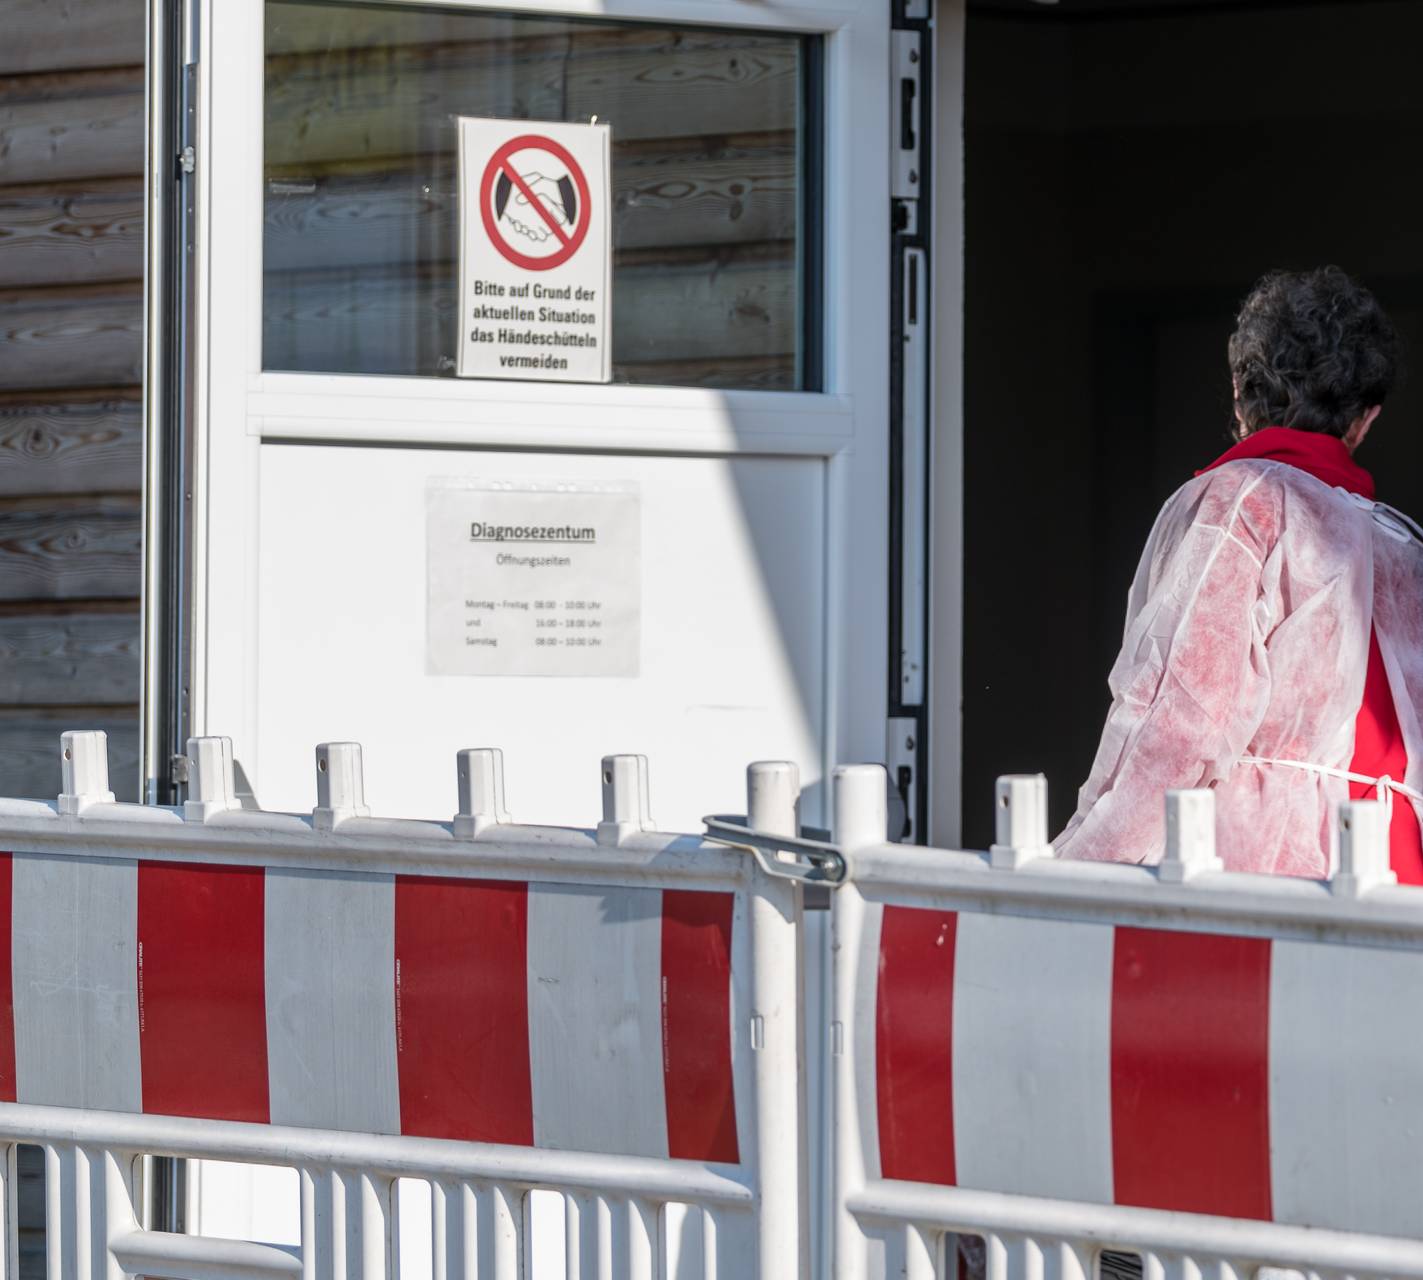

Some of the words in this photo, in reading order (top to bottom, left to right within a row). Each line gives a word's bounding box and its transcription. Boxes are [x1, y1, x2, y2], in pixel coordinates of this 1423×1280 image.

[474, 280, 505, 297] Bitte
[509, 283, 529, 298] auf
[533, 283, 571, 300] Grund
[575, 286, 595, 301] der
[473, 304, 535, 321] aktuellen
[539, 307, 596, 324] Situation
[470, 327, 494, 343] das
[498, 328, 597, 347] Händeschütteln
[499, 353, 568, 369] vermeiden
[496, 553, 571, 568] Öffnungszeiten
[465, 600, 495, 610] Montag
[587, 601, 601, 610] Uhr
[466, 619, 481, 627] und
[587, 619, 602, 628] Uhr
[587, 638, 602, 646] Uhr
